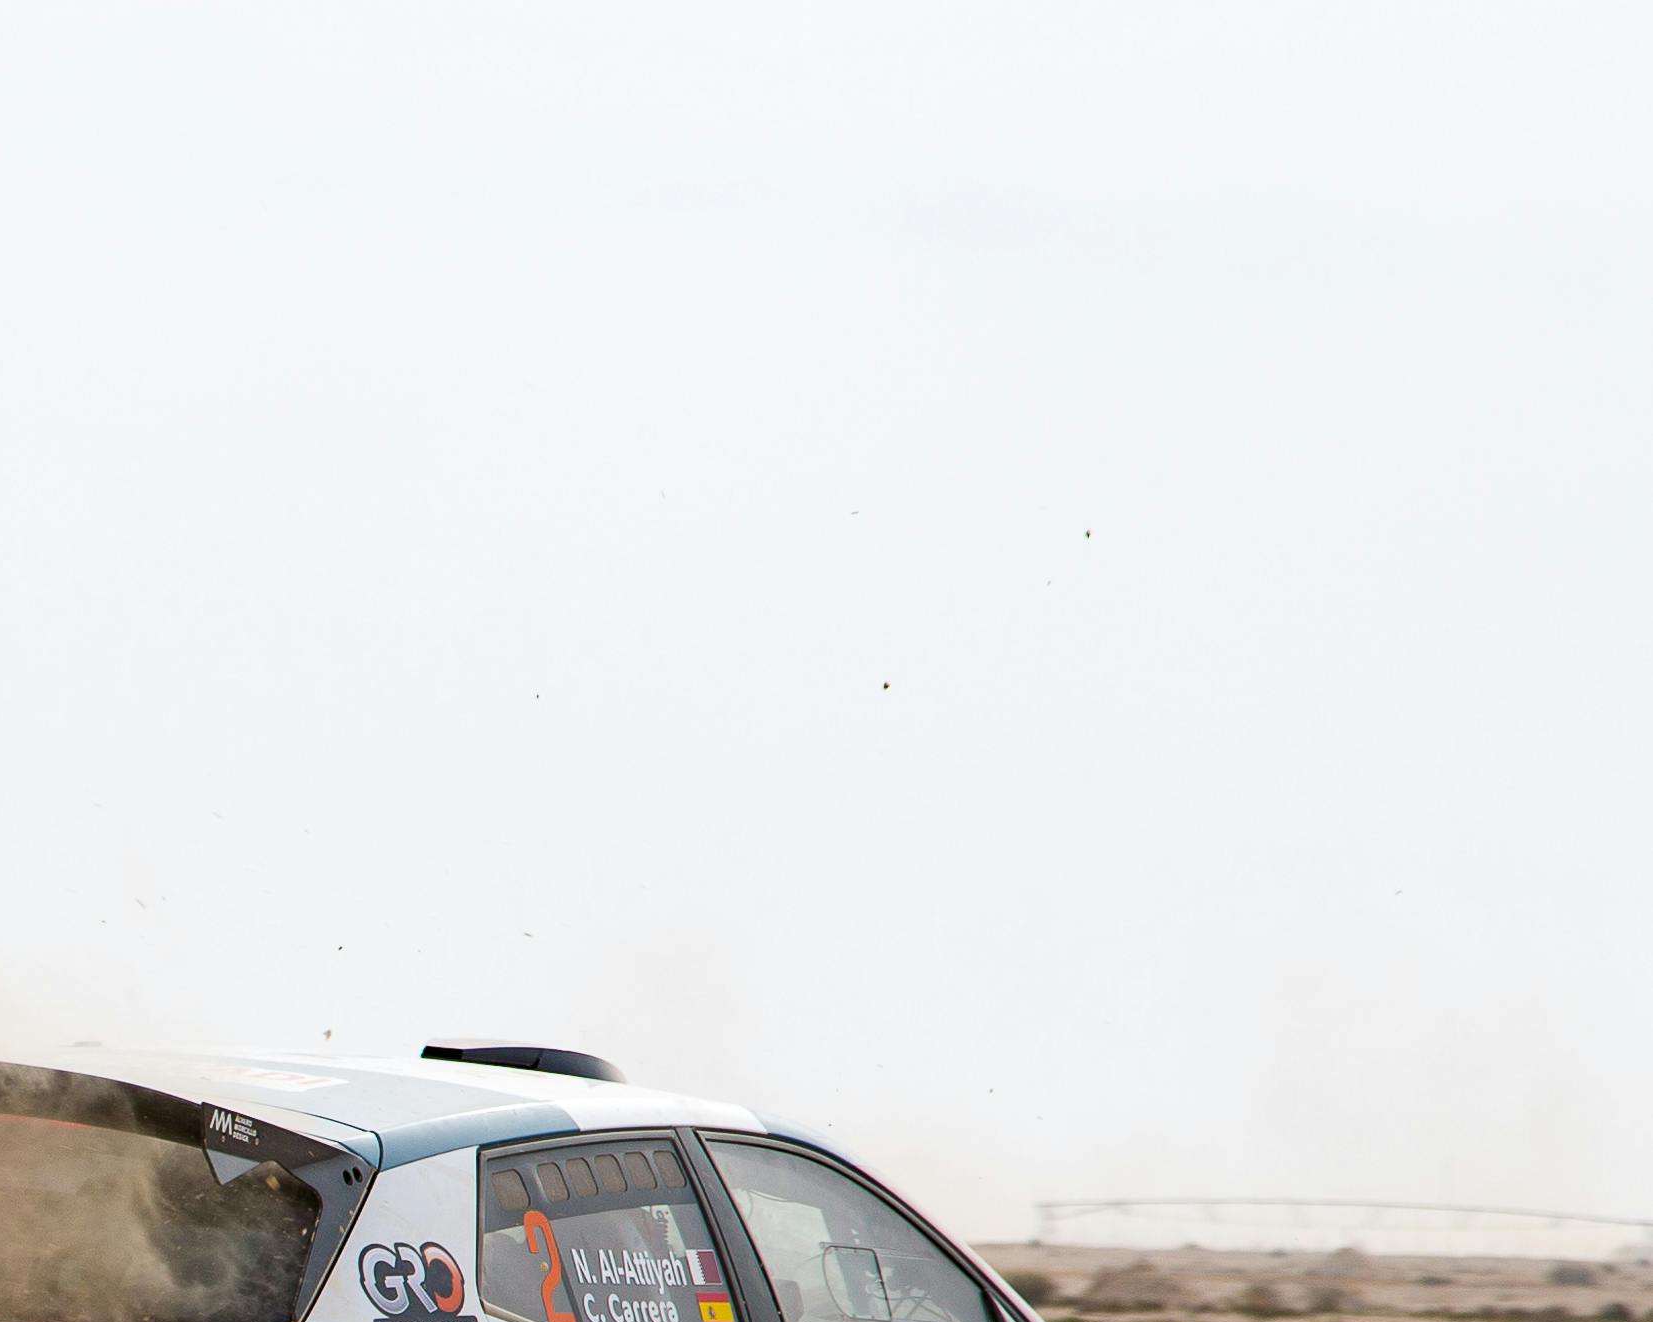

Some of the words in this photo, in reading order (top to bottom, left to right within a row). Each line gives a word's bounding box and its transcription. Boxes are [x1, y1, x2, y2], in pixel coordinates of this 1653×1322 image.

[361, 1243, 464, 1315] GRO
[570, 1248, 596, 1286] N.
[599, 1249, 689, 1298] Al-Attiyah
